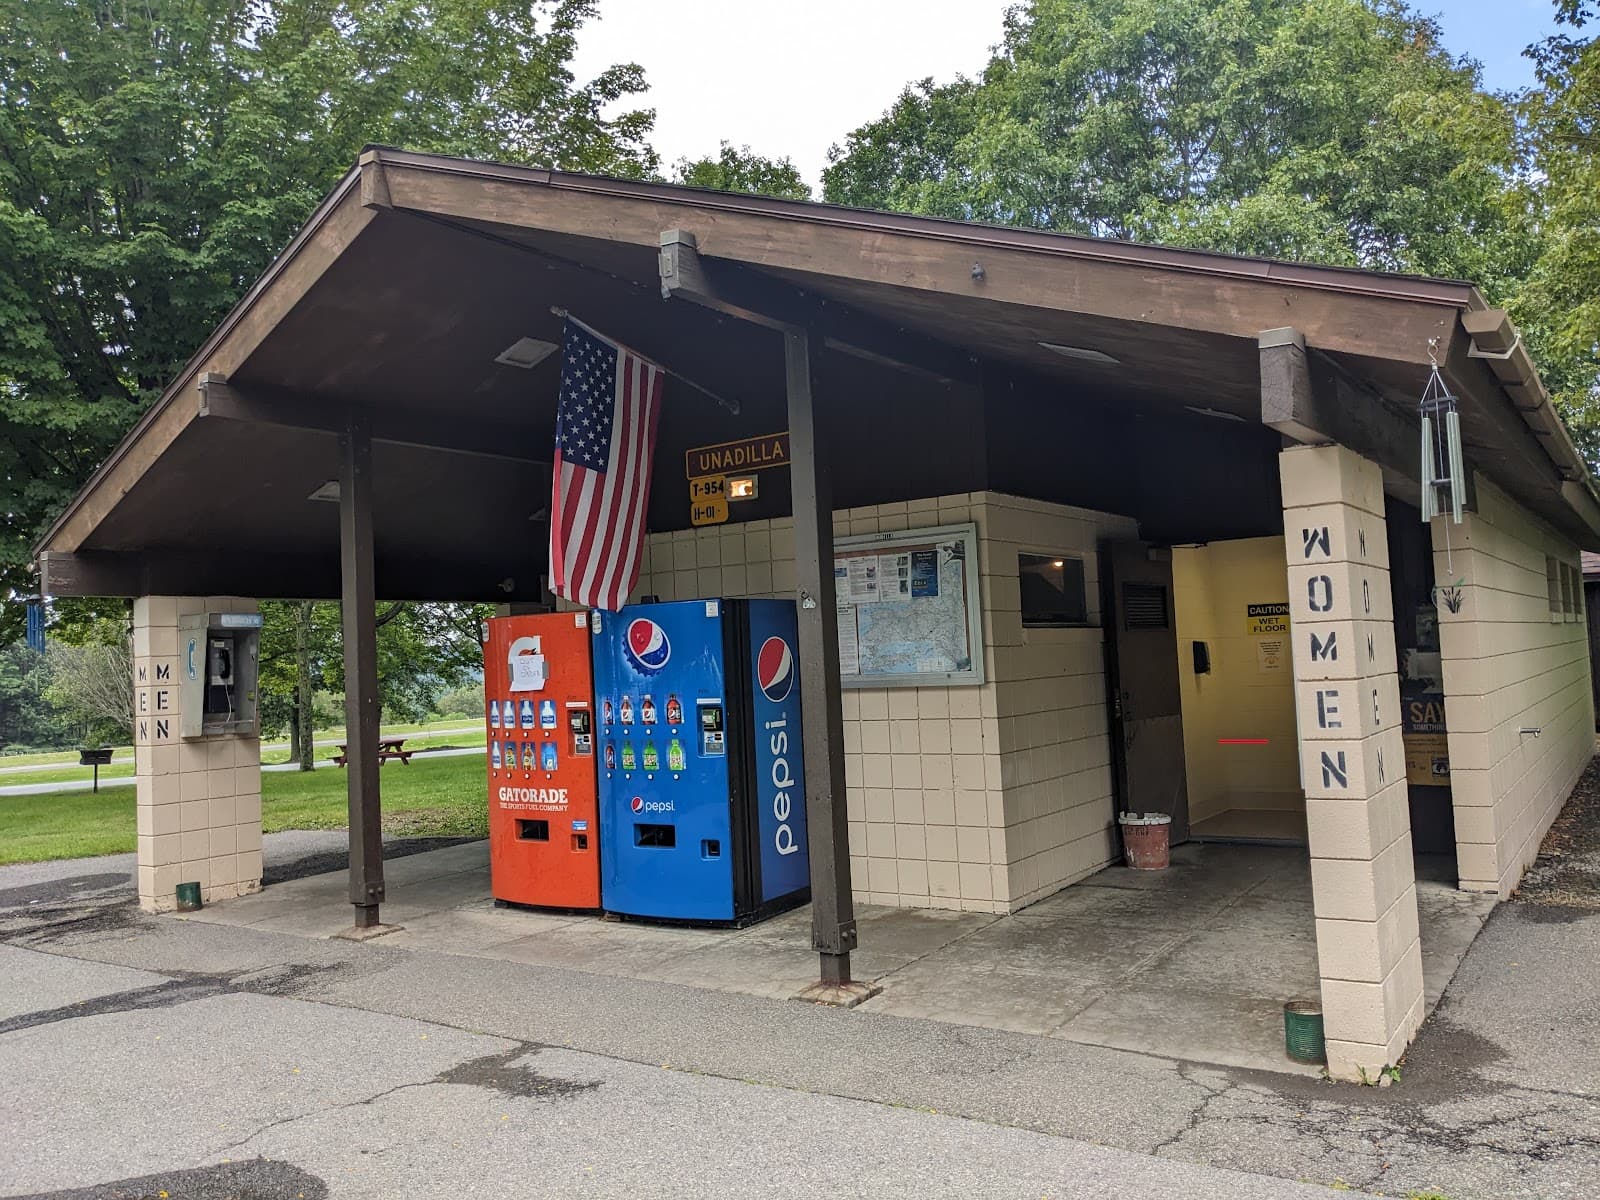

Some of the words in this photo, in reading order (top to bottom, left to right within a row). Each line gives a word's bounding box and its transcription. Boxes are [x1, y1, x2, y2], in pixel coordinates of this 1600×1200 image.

[700, 441, 784, 471] UNADILLA
[693, 480, 724, 497] T-954
[1249, 605, 1289, 615] CAUTION
[1253, 624, 1287, 633] FLOOR
[1259, 617, 1280, 625] WET
[1302, 526, 1348, 788] WOMEN
[157, 664, 169, 739] MEN
[1413, 723, 1446, 732] SOMETHIN
[499, 787, 568, 804] GATORADE
[765, 719, 799, 856] pepsi
[539, 804, 569, 812] COMPANY
[645, 799, 674, 814] pepsi
